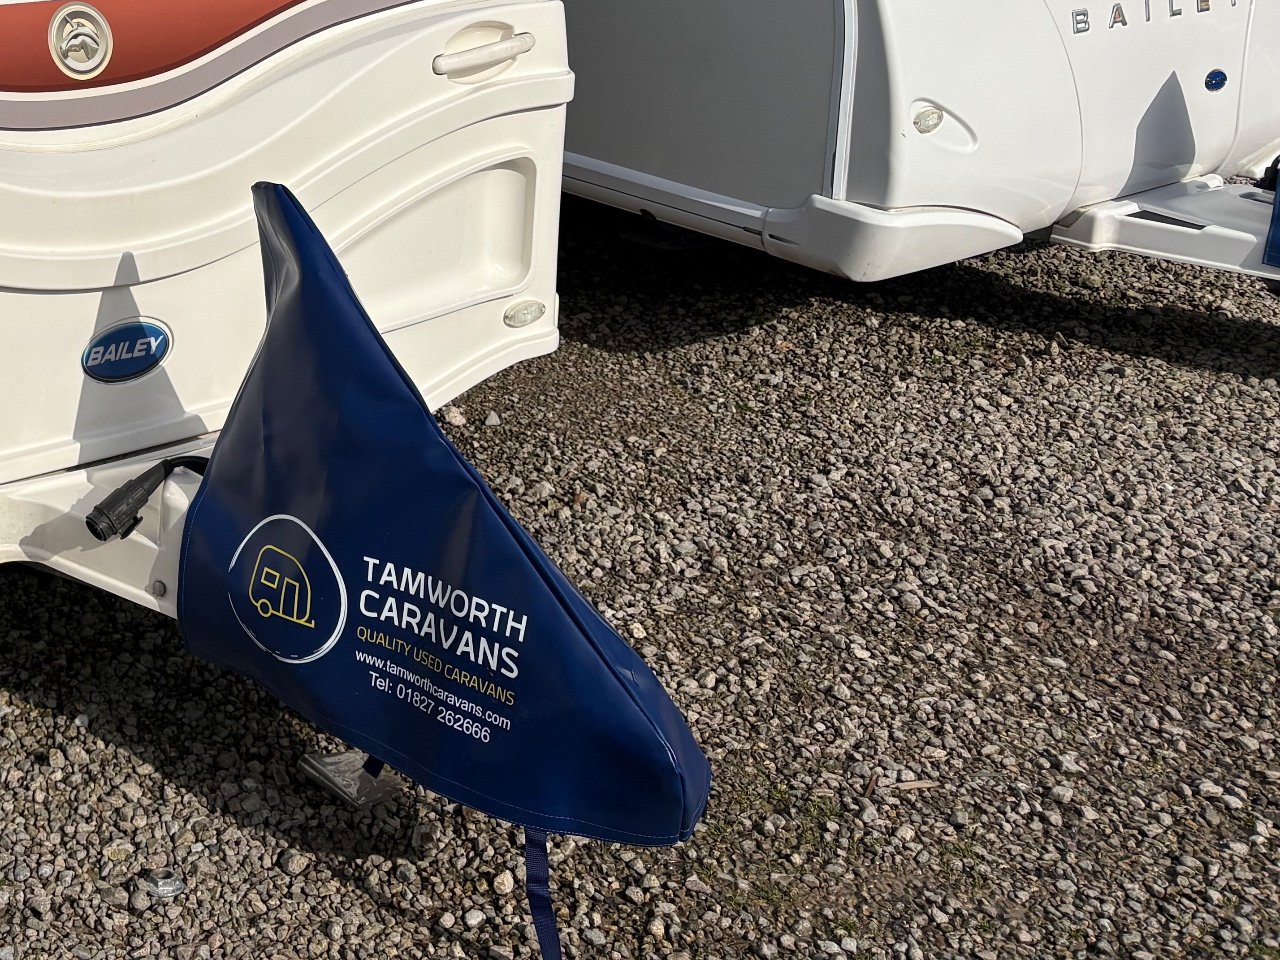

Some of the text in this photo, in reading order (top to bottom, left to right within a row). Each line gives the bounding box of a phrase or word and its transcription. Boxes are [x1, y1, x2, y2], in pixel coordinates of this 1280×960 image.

[86, 335, 165, 367] BAILEY
[359, 589, 519, 679] CARAVANS
[363, 556, 528, 642] TAMWORTH
[355, 650, 511, 731] www.tamworthcaravans.com
[356, 626, 516, 706] QUALITY USED CARAVANS
[369, 671, 491, 743] Tel: 01827 262666
